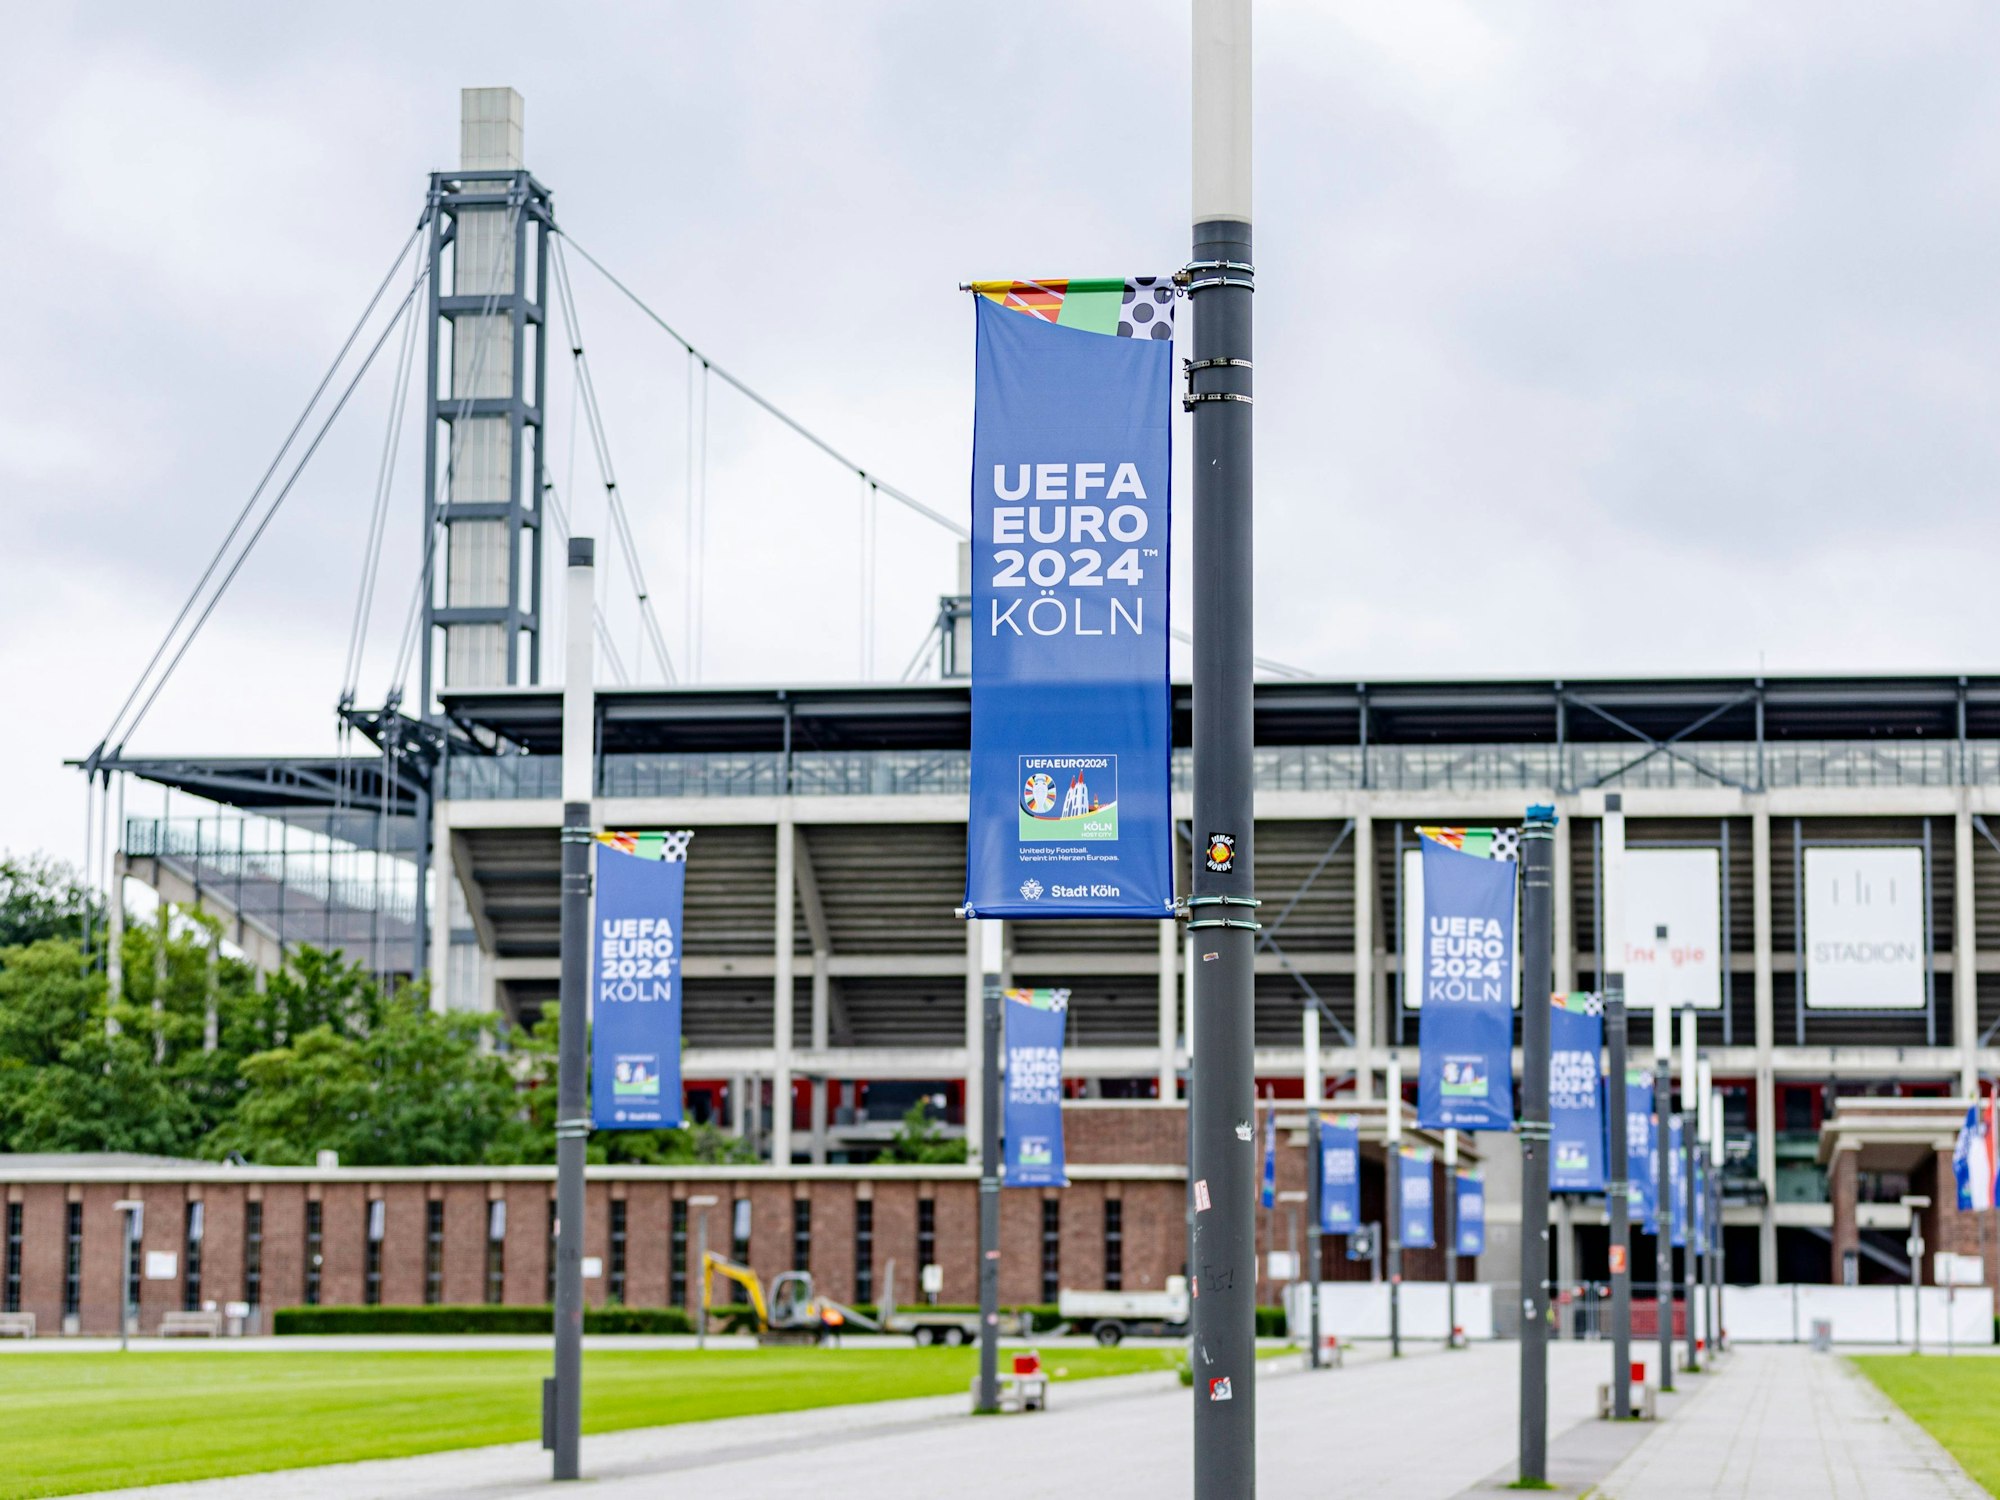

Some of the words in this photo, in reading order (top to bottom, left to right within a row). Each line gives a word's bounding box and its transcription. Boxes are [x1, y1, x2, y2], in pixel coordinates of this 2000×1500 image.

[993, 462, 1148, 501] UEFA
[992, 504, 1149, 544] EURO
[991, 589, 1143, 636] KÖLN
[1084, 820, 1112, 831] KÖLN
[1211, 834, 1234, 846] JUNGE
[1045, 847, 1055, 856] by
[1086, 854, 1120, 863] Europas.
[1051, 885, 1088, 897] Stadt
[1090, 884, 1120, 897] Köln
[602, 918, 673, 939] UEFA
[1430, 916, 1503, 940] UEFA
[602, 939, 674, 959] EURO
[1430, 936, 1504, 960] EURO
[1814, 940, 1916, 964] STADION
[600, 979, 671, 1002] KÖLN
[1429, 978, 1502, 1003] KÖLN
[1010, 1047, 1059, 1061] UEFA
[1010, 1060, 1060, 1074] EURO
